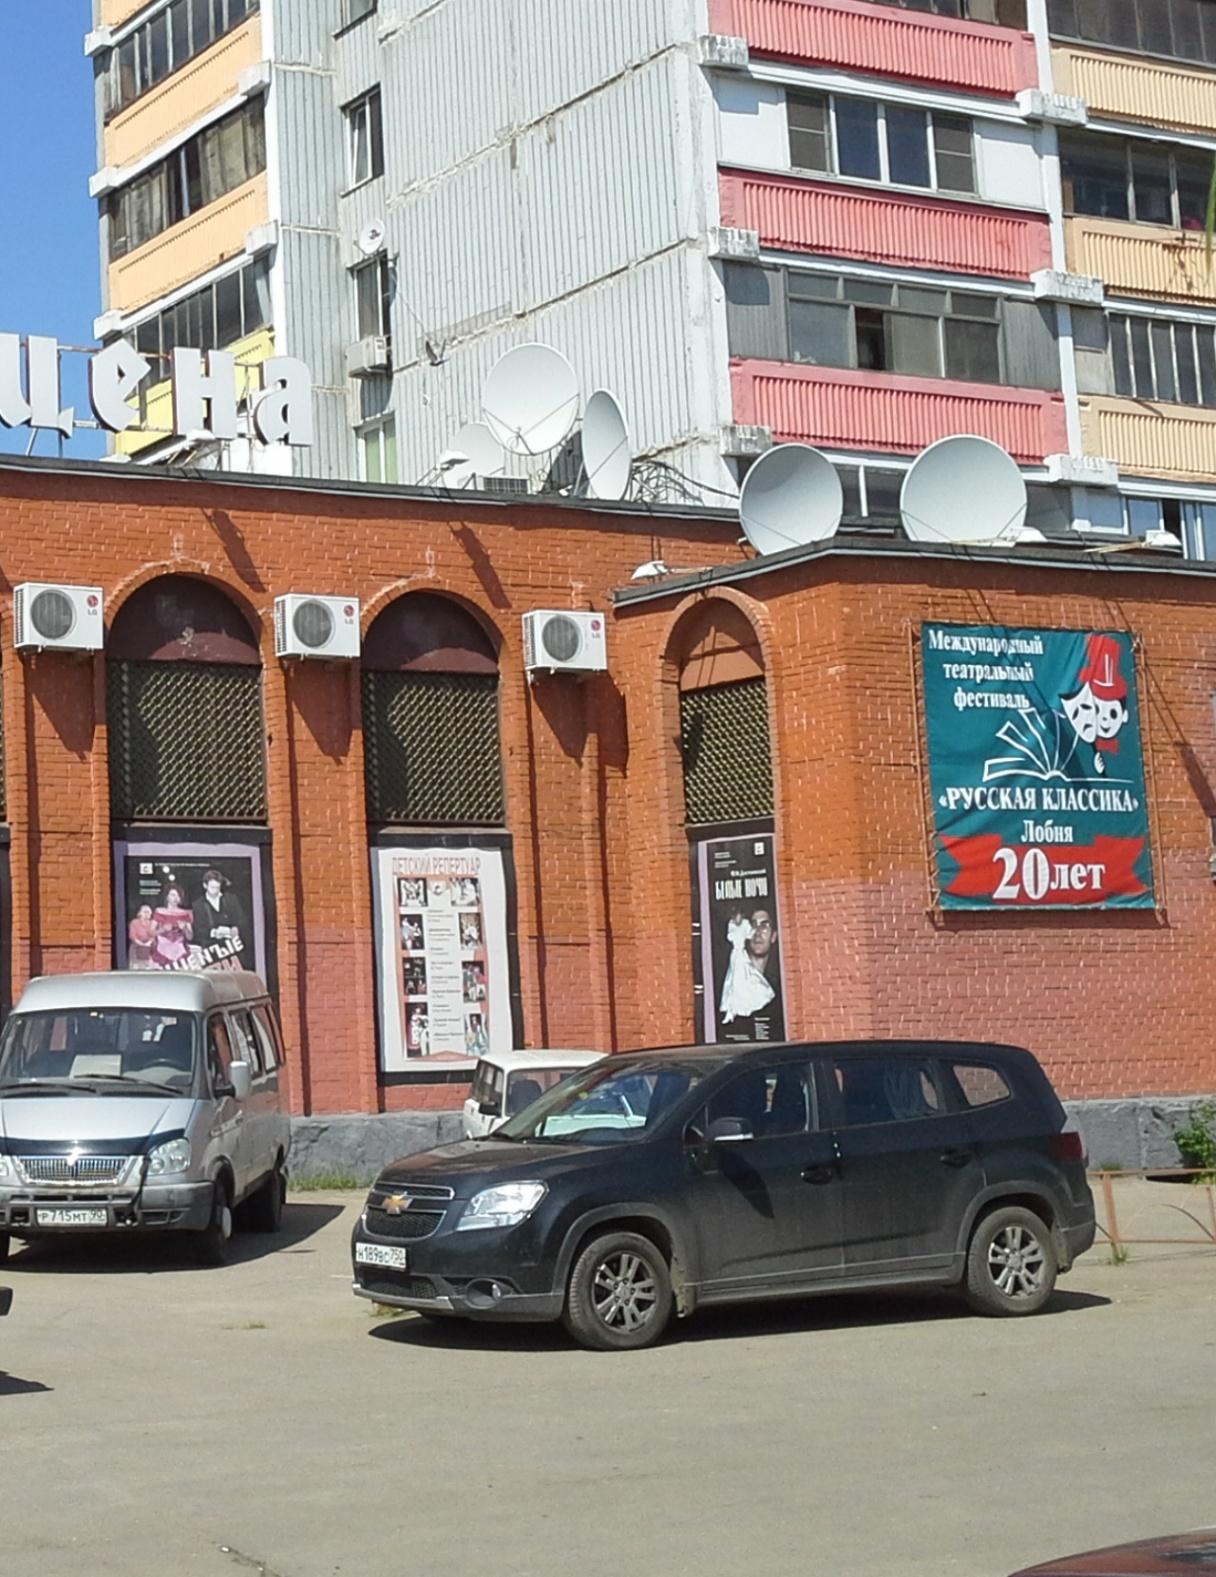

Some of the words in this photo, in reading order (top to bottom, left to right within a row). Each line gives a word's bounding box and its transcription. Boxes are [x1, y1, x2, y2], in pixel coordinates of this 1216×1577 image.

[929, 629, 1044, 655] Международный
[943, 661, 1034, 682] театральный
[953, 687, 1031, 711] фестиваль
[939, 786, 1036, 810] «РУССКАЯ
[1042, 788, 1139, 812] КЛАССИКА»
[1021, 819, 1074, 843] Лобня
